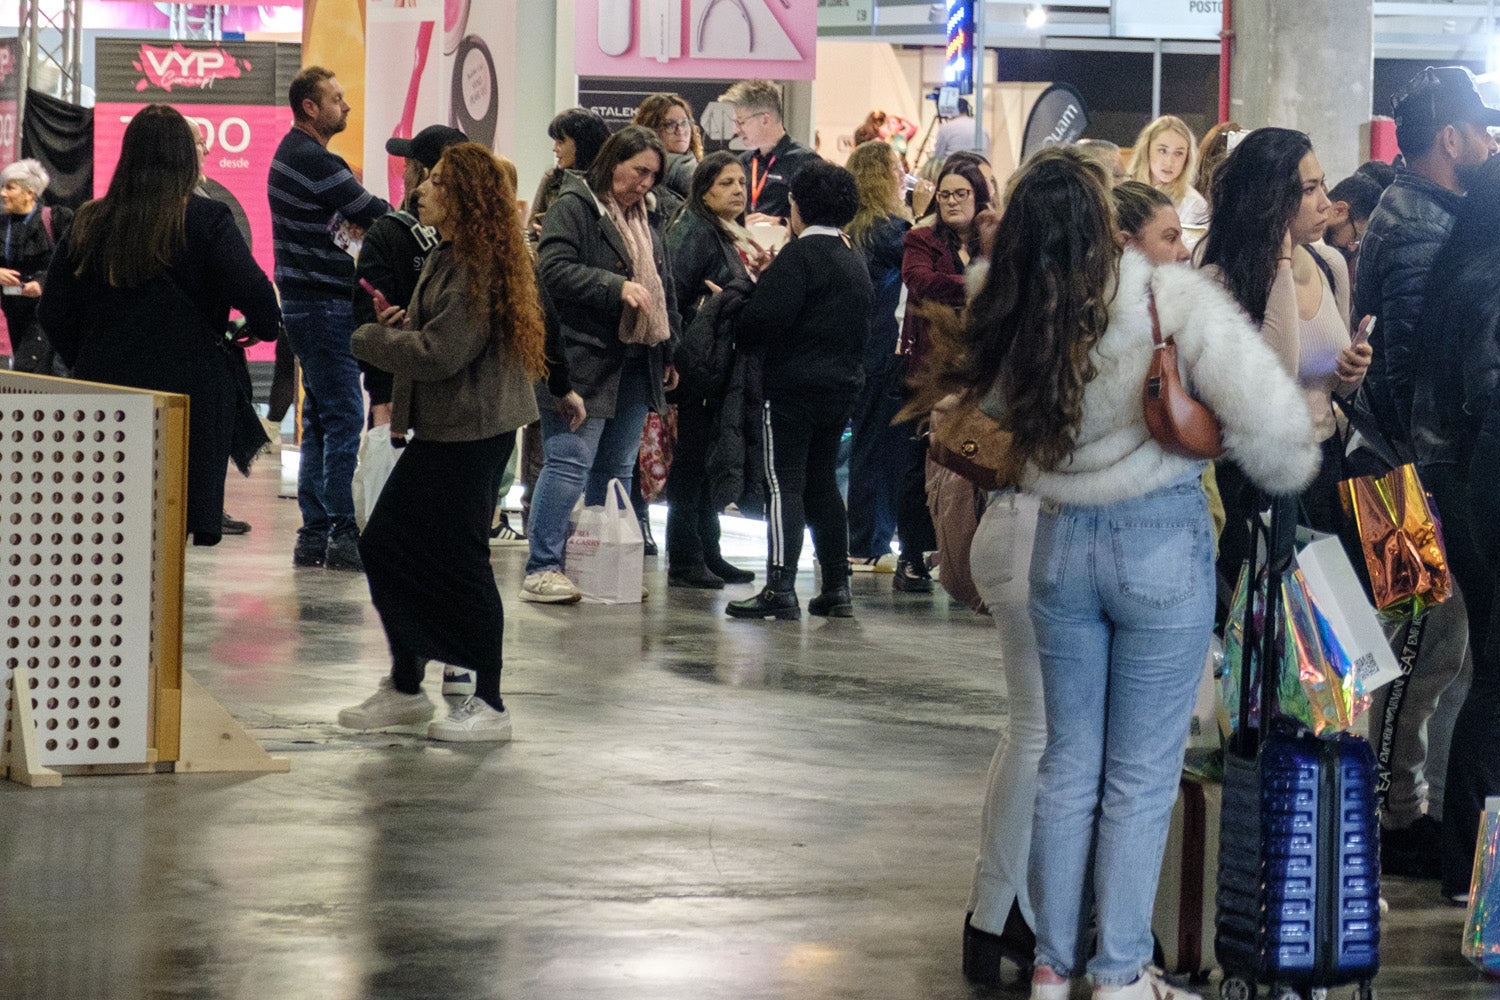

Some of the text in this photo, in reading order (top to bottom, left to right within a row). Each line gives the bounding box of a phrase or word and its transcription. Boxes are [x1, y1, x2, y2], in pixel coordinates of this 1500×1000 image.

[145, 50, 225, 76] VYP
[590, 106, 640, 118] STALEK
[219, 157, 250, 169] desde
[1401, 646, 1416, 675] EA7
